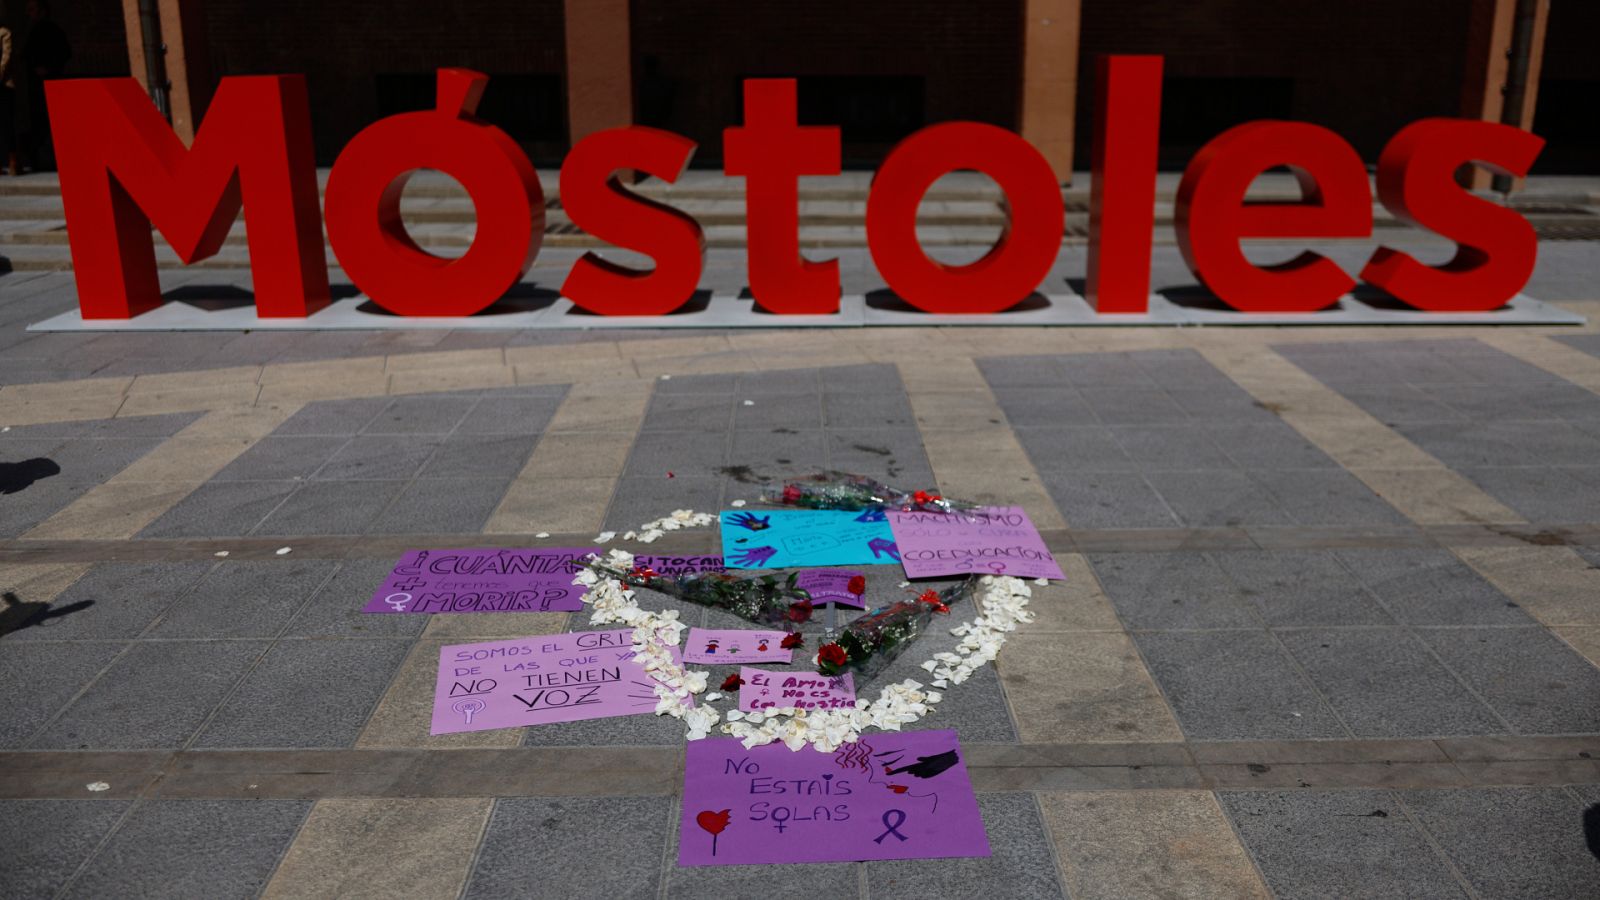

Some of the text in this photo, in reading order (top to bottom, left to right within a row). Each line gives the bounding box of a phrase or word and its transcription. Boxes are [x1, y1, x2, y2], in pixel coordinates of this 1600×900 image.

[44, 55, 1546, 319] Móstoles
[657, 556, 724, 567] TOCAN
[454, 645, 532, 662] SOMOS
[541, 643, 564, 654] EL
[454, 666, 482, 677] DE
[503, 661, 541, 673] LAS
[558, 655, 599, 668] QUE
[449, 666, 622, 697] NO TIENEN
[513, 685, 602, 709] VOZ
